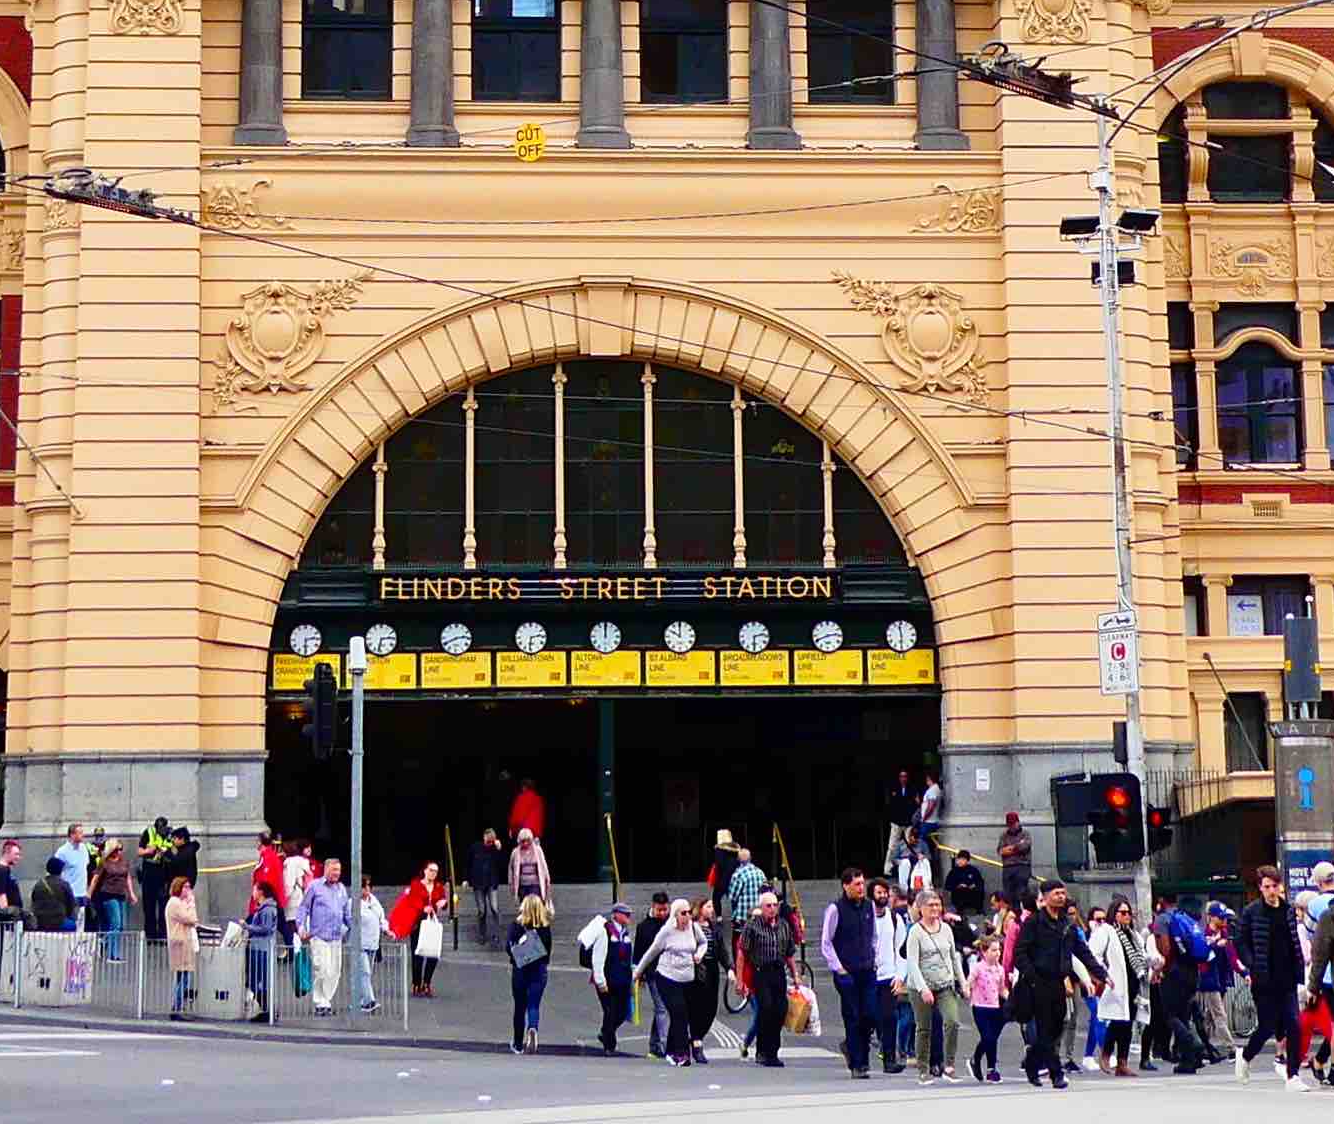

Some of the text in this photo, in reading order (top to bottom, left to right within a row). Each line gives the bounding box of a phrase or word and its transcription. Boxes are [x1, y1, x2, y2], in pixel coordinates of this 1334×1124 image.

[516, 127, 540, 141] CUT
[518, 143, 542, 157] OFF
[380, 576, 832, 600] FLINDERS STREET STATION
[500, 654, 555, 662] WILLIAMSTOWN
[575, 653, 603, 661] ALTONA
[796, 652, 827, 661] UPFIELD
[1112, 643, 1125, 660] C
